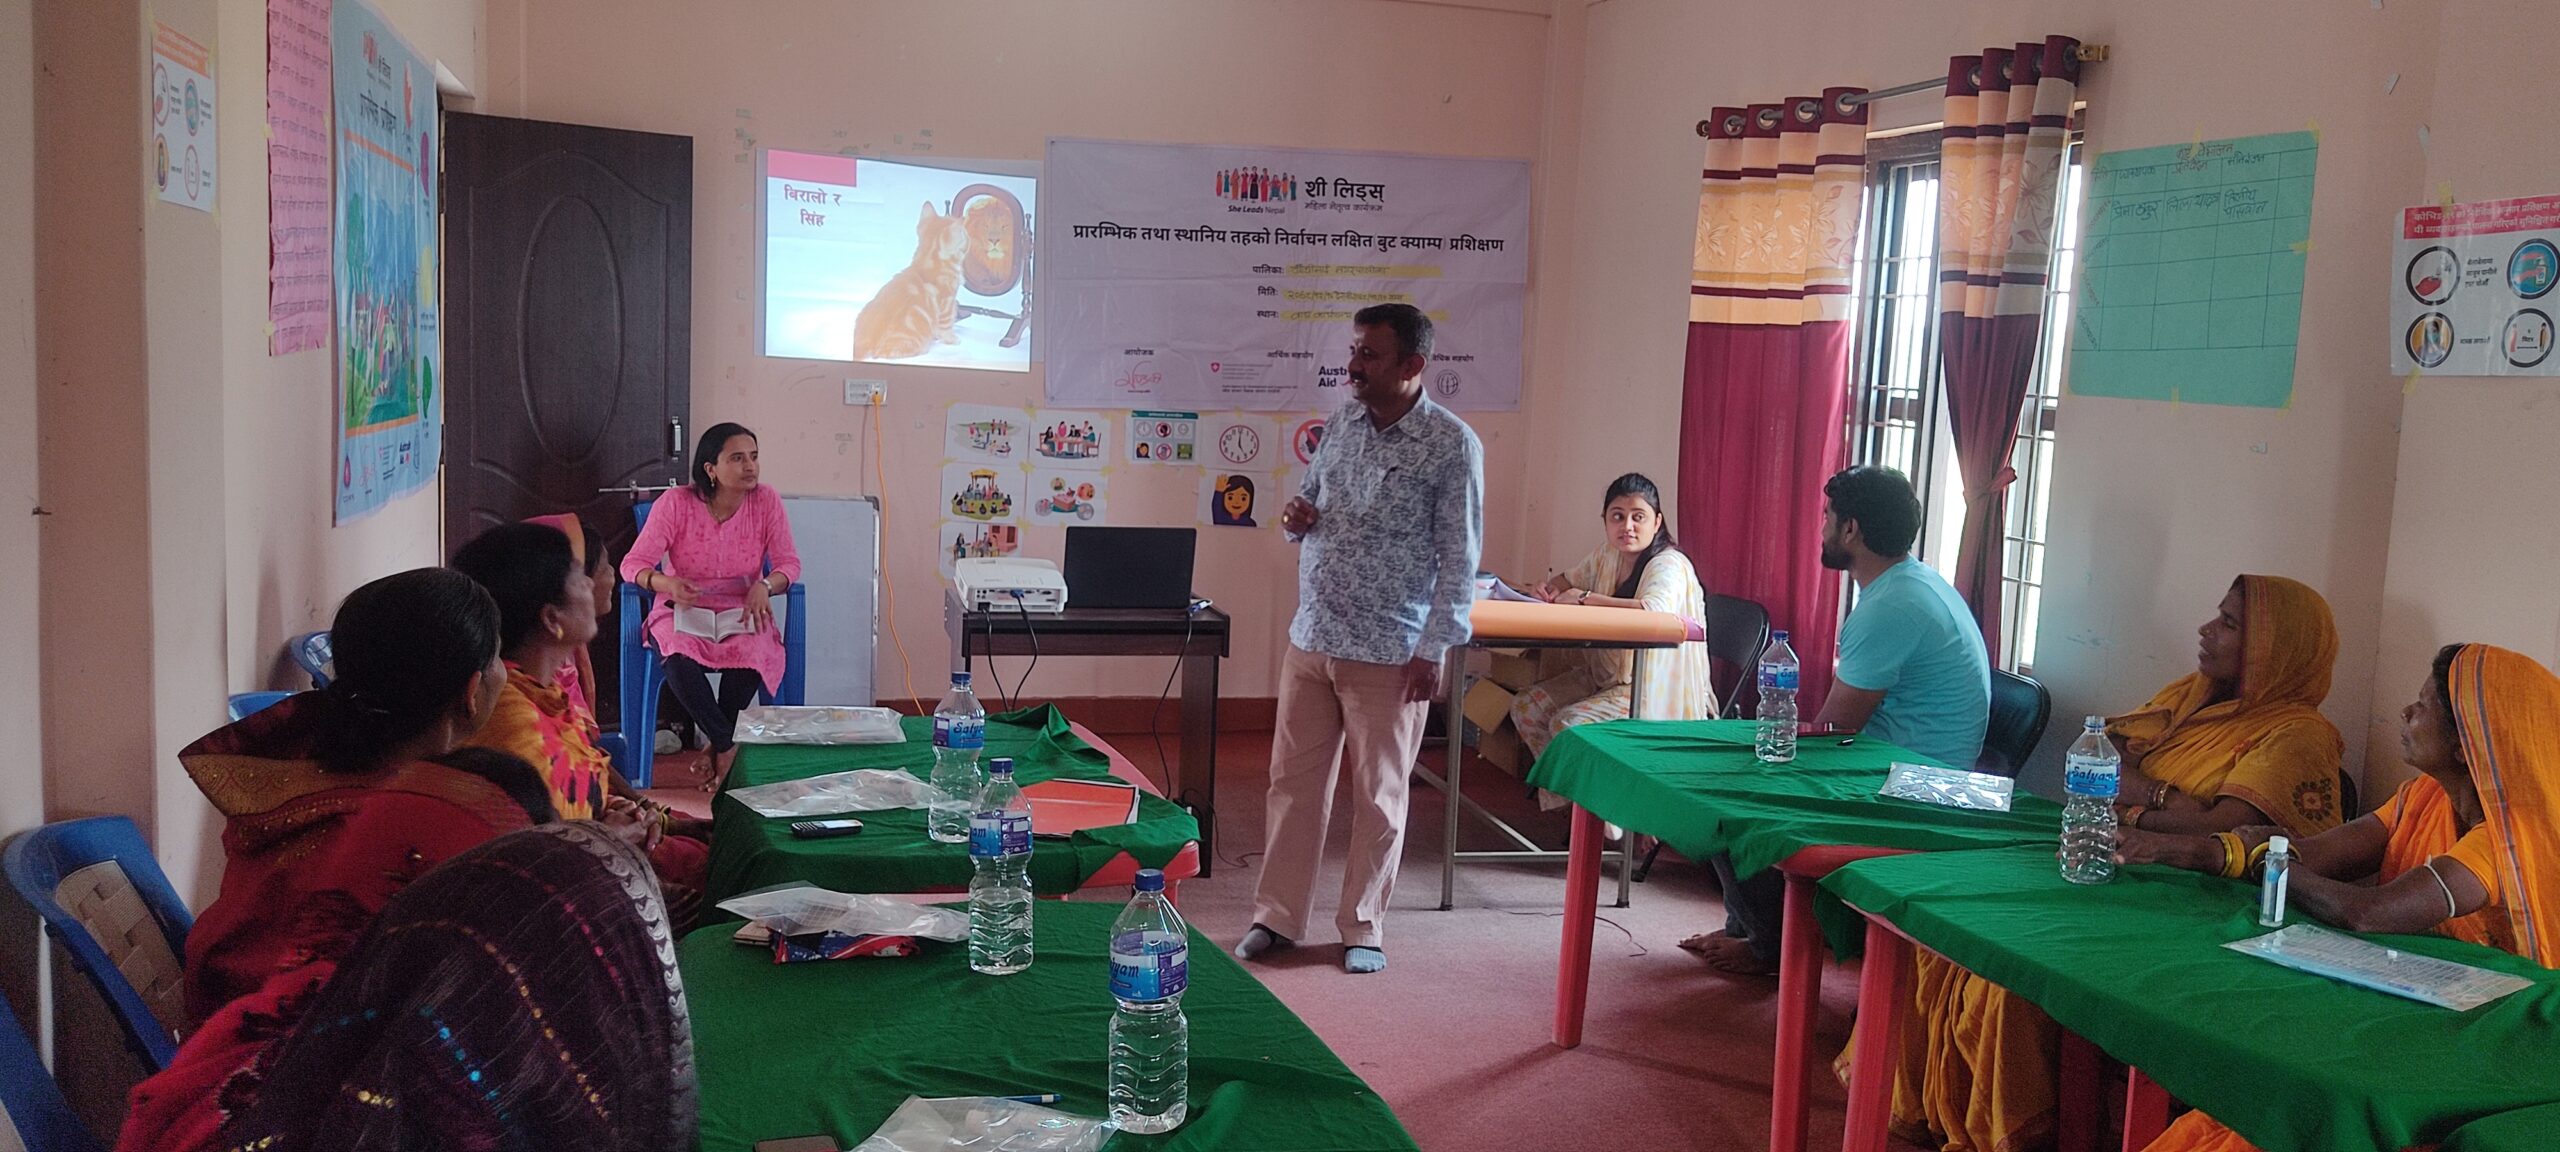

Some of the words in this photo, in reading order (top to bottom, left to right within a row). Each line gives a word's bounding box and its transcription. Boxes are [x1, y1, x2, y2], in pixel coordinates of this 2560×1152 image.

[1305, 176, 1328, 198] शी
[832, 193, 842, 206] र
[800, 208, 826, 227] सिंह
[1228, 205, 1241, 213] She
[1242, 205, 1264, 214] Leads
[1265, 206, 1285, 215] Nepal
[1073, 221, 1137, 241] प्रारम्भिक
[1141, 226, 1170, 241] तथा
[1174, 225, 1227, 243] स्थानिय
[1230, 227, 1271, 246] तहको
[1274, 227, 1328, 247] निर्वाचन
[1331, 230, 1374, 248] लक्षित
[1400, 236, 1443, 251] क्याम्प
[1449, 233, 1504, 252] प्रशिक्षण
[1318, 377, 1337, 388] Aid
